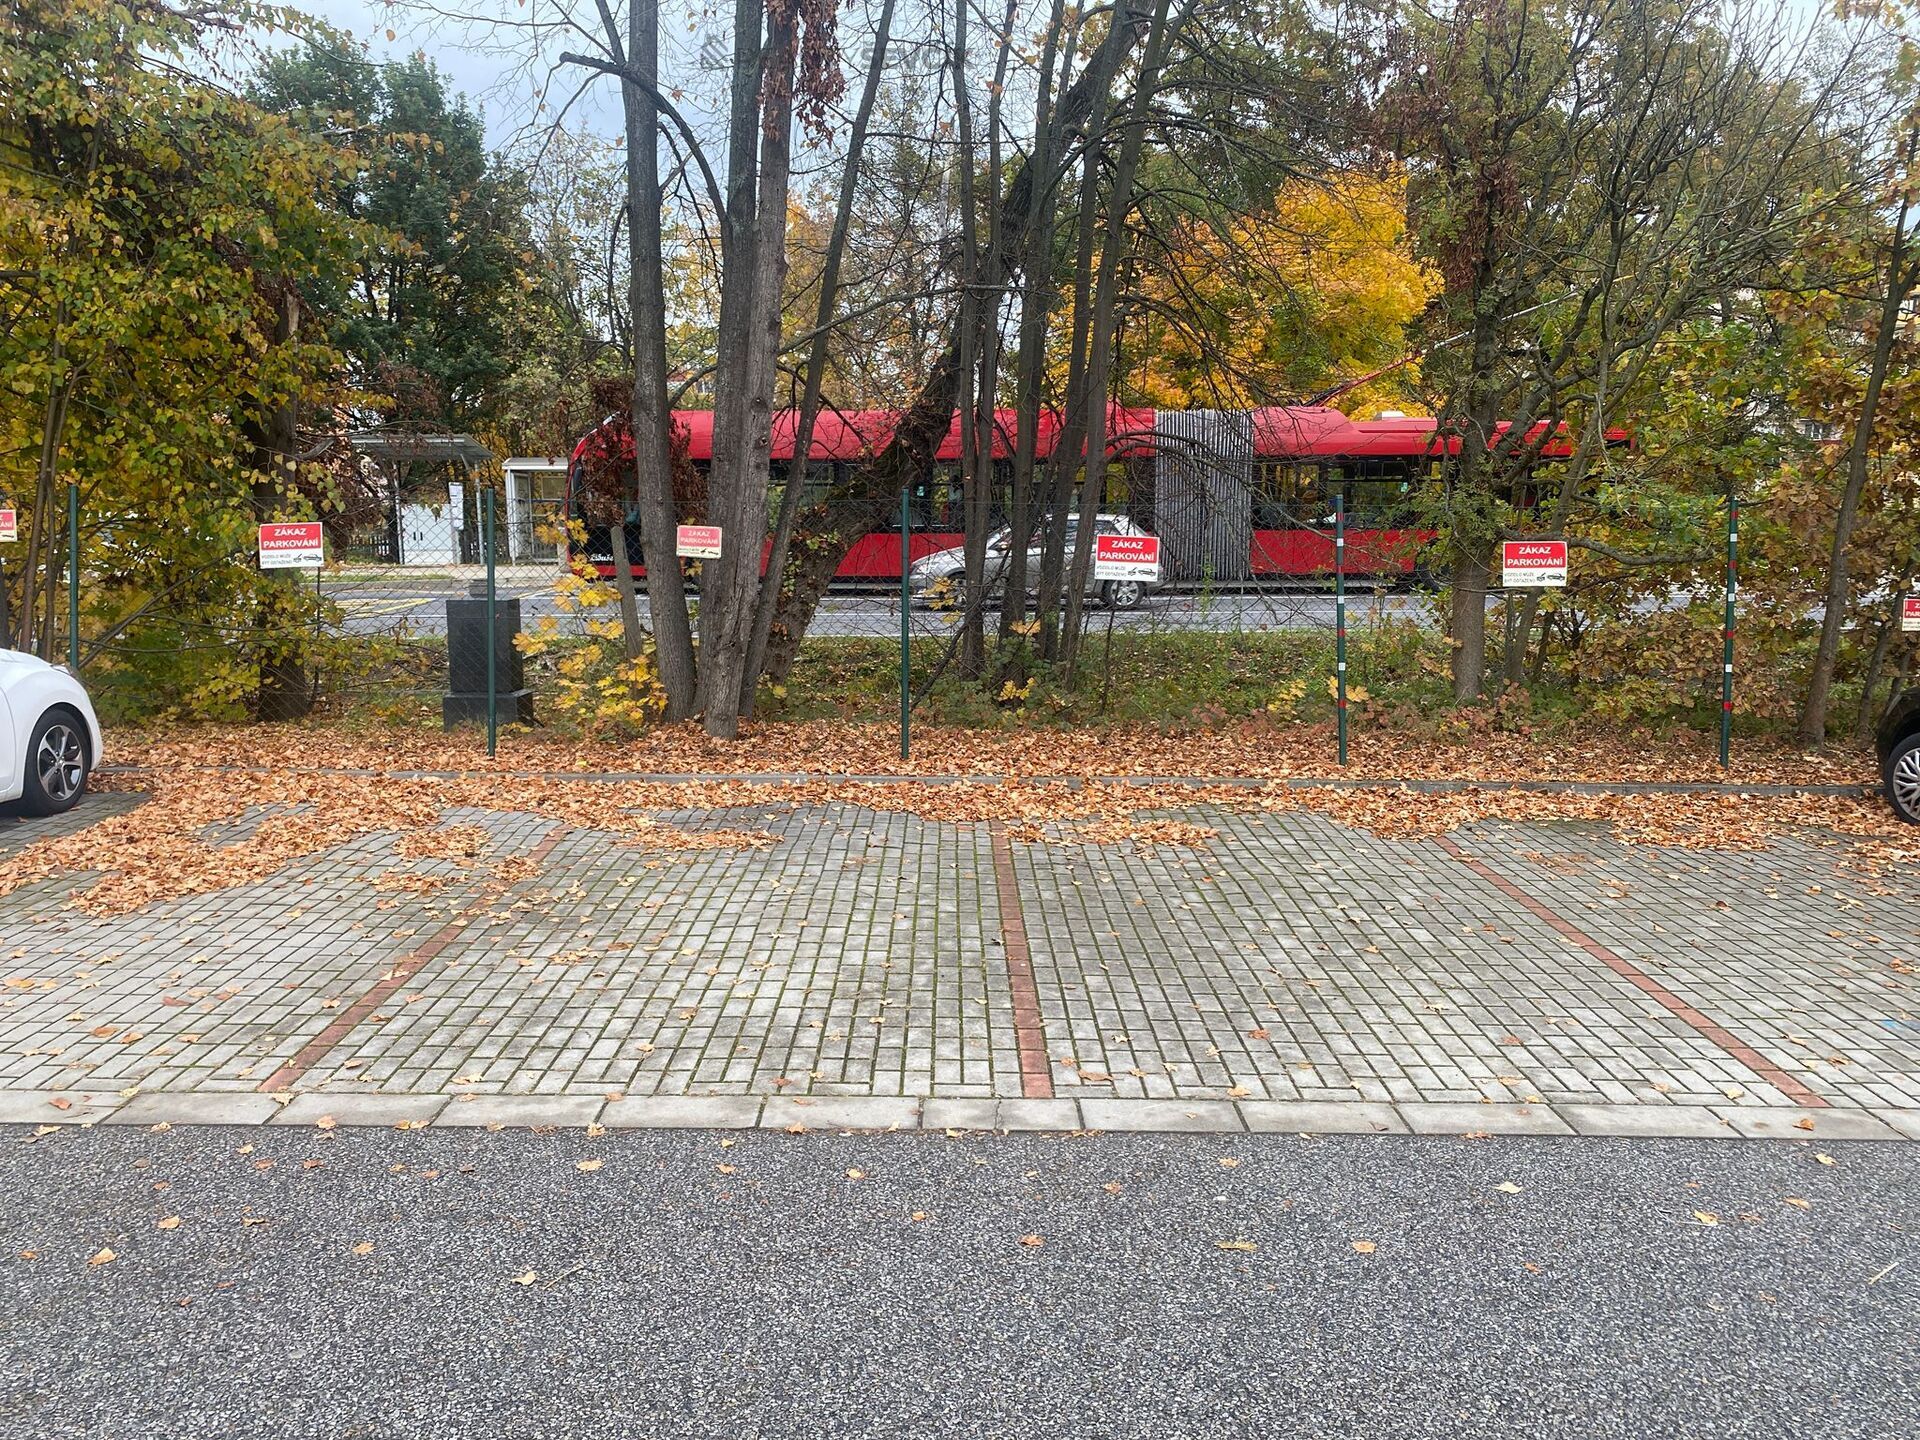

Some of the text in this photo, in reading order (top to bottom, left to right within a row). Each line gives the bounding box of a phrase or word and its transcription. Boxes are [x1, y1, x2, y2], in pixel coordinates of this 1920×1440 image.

[274, 527, 307, 536] ZÁKAZ
[263, 537, 318, 548] PARKOVÁNÍ
[1111, 540, 1144, 549] ZÁKAZ
[1519, 545, 1551, 554] ZÁKAZ
[1100, 551, 1154, 561] PARKOVÁNÍ
[1507, 556, 1563, 566] PARKOVÁNÍ
